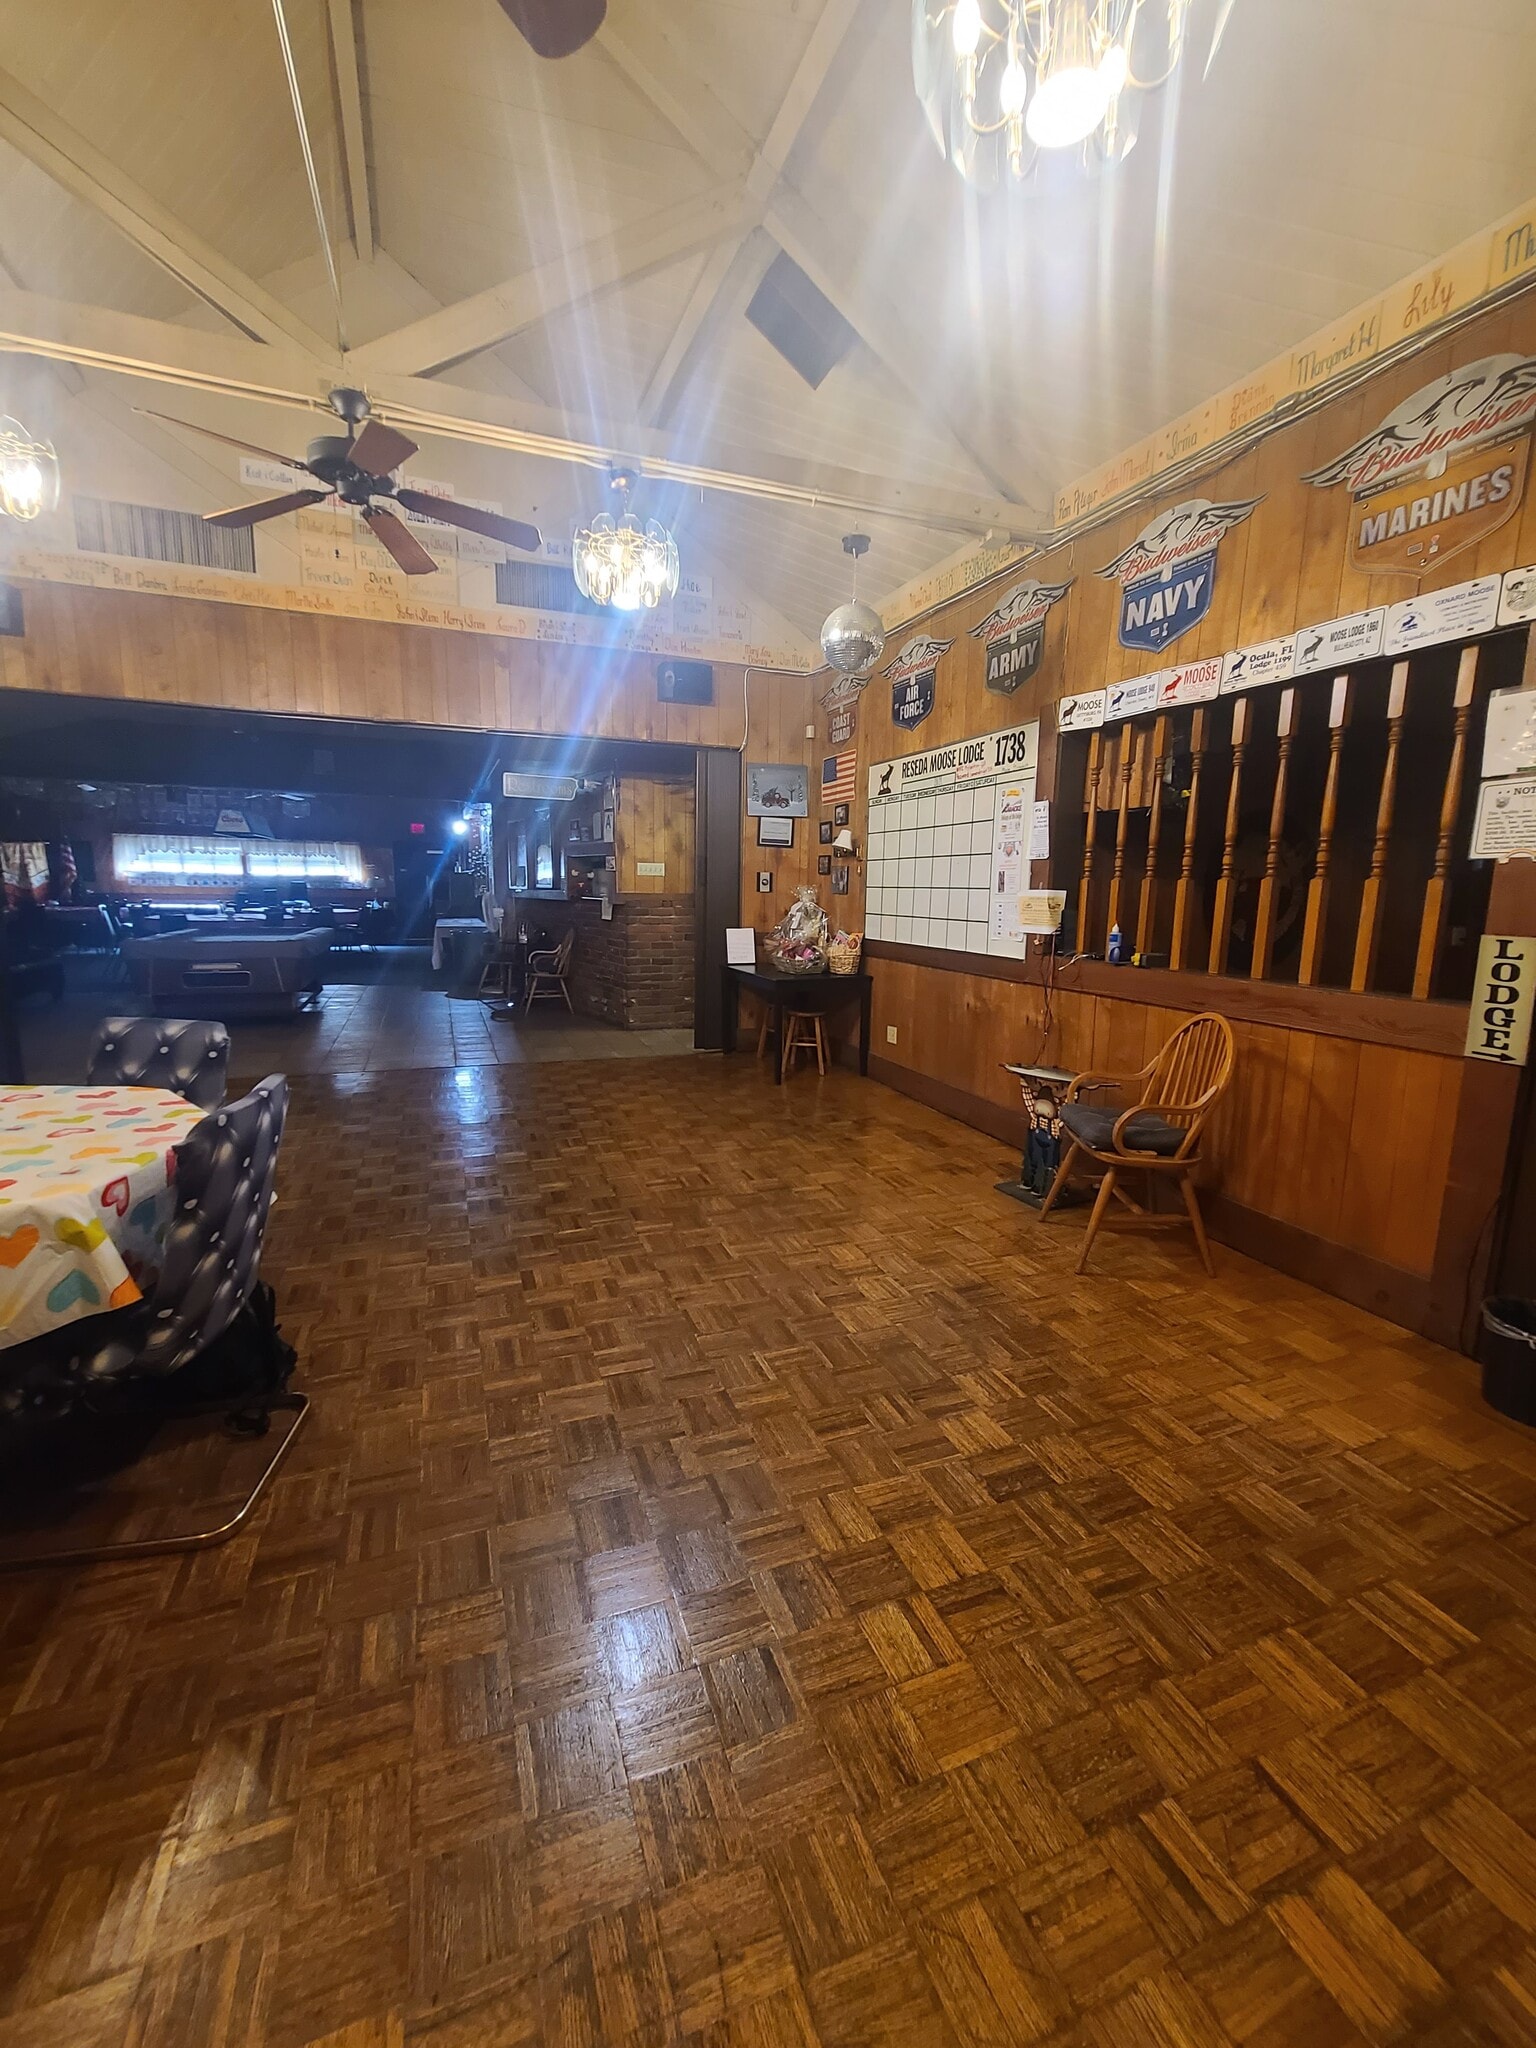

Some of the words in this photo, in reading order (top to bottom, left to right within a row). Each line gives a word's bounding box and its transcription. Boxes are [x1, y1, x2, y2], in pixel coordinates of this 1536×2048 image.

[1346, 392, 1536, 489] Budweiser
[1358, 464, 1513, 549] MARINES
[1118, 526, 1222, 584] Budweiser
[1124, 573, 1207, 633] NAVY
[1435, 593, 1466, 606] OXNARD
[1467, 584, 1496, 597] MOOSE
[983, 605, 1047, 641] Budweiser
[1329, 628, 1347, 643] MOOSE
[1348, 624, 1365, 638] LODGE
[988, 639, 1038, 681] ARMY
[1249, 650, 1279, 663] Ocala,
[1281, 644, 1295, 656] FL
[1249, 661, 1271, 670] Lodge
[1273, 655, 1293, 665] 1199
[889, 655, 939, 682] Budweiser
[1183, 664, 1218, 686] MOOSE
[905, 684, 919, 703] AIR
[899, 698, 925, 721] FORCE
[1077, 698, 1103, 712] MOOSE
[832, 712, 850, 728] COAST
[831, 727, 850, 744] GUARD
[994, 730, 1026, 767] 1738
[901, 756, 928, 780] RESEDA
[929, 749, 957, 773] MOOSE
[958, 741, 986, 766] LODGE
[917, 789, 937, 797] WEDNESDAY
[937, 786, 955, 794] THURSDAY
[975, 777, 995, 786] SATURDAY
[605, 814, 612, 829] A
[1480, 939, 1525, 1051] LODGE
